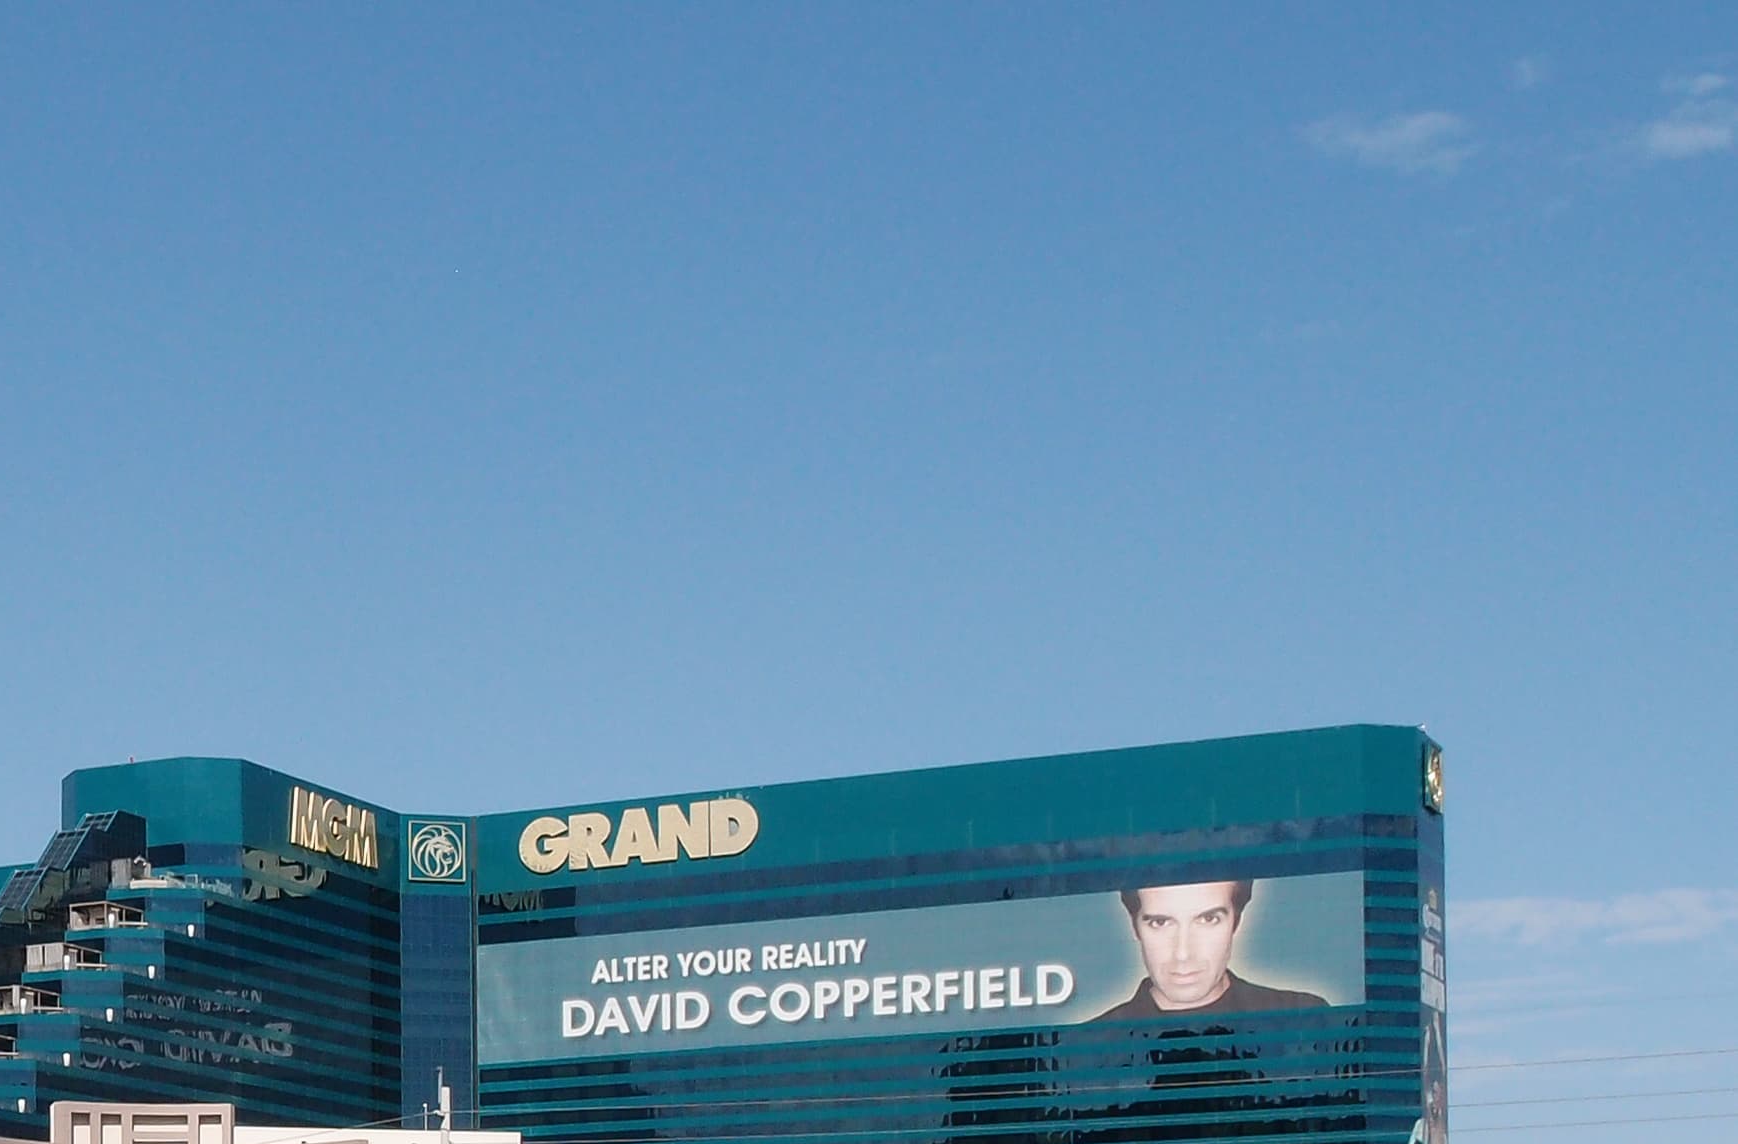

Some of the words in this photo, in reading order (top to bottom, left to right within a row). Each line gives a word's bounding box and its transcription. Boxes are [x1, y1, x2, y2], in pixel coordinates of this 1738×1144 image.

[289, 786, 378, 869] MGM
[518, 798, 760, 874] GRAND
[591, 955, 668, 984] ALTER
[677, 948, 751, 977] YOUR
[762, 938, 867, 970] REALITY
[562, 991, 710, 1038] DAVID
[728, 964, 1074, 1026] COPPERFIELD
